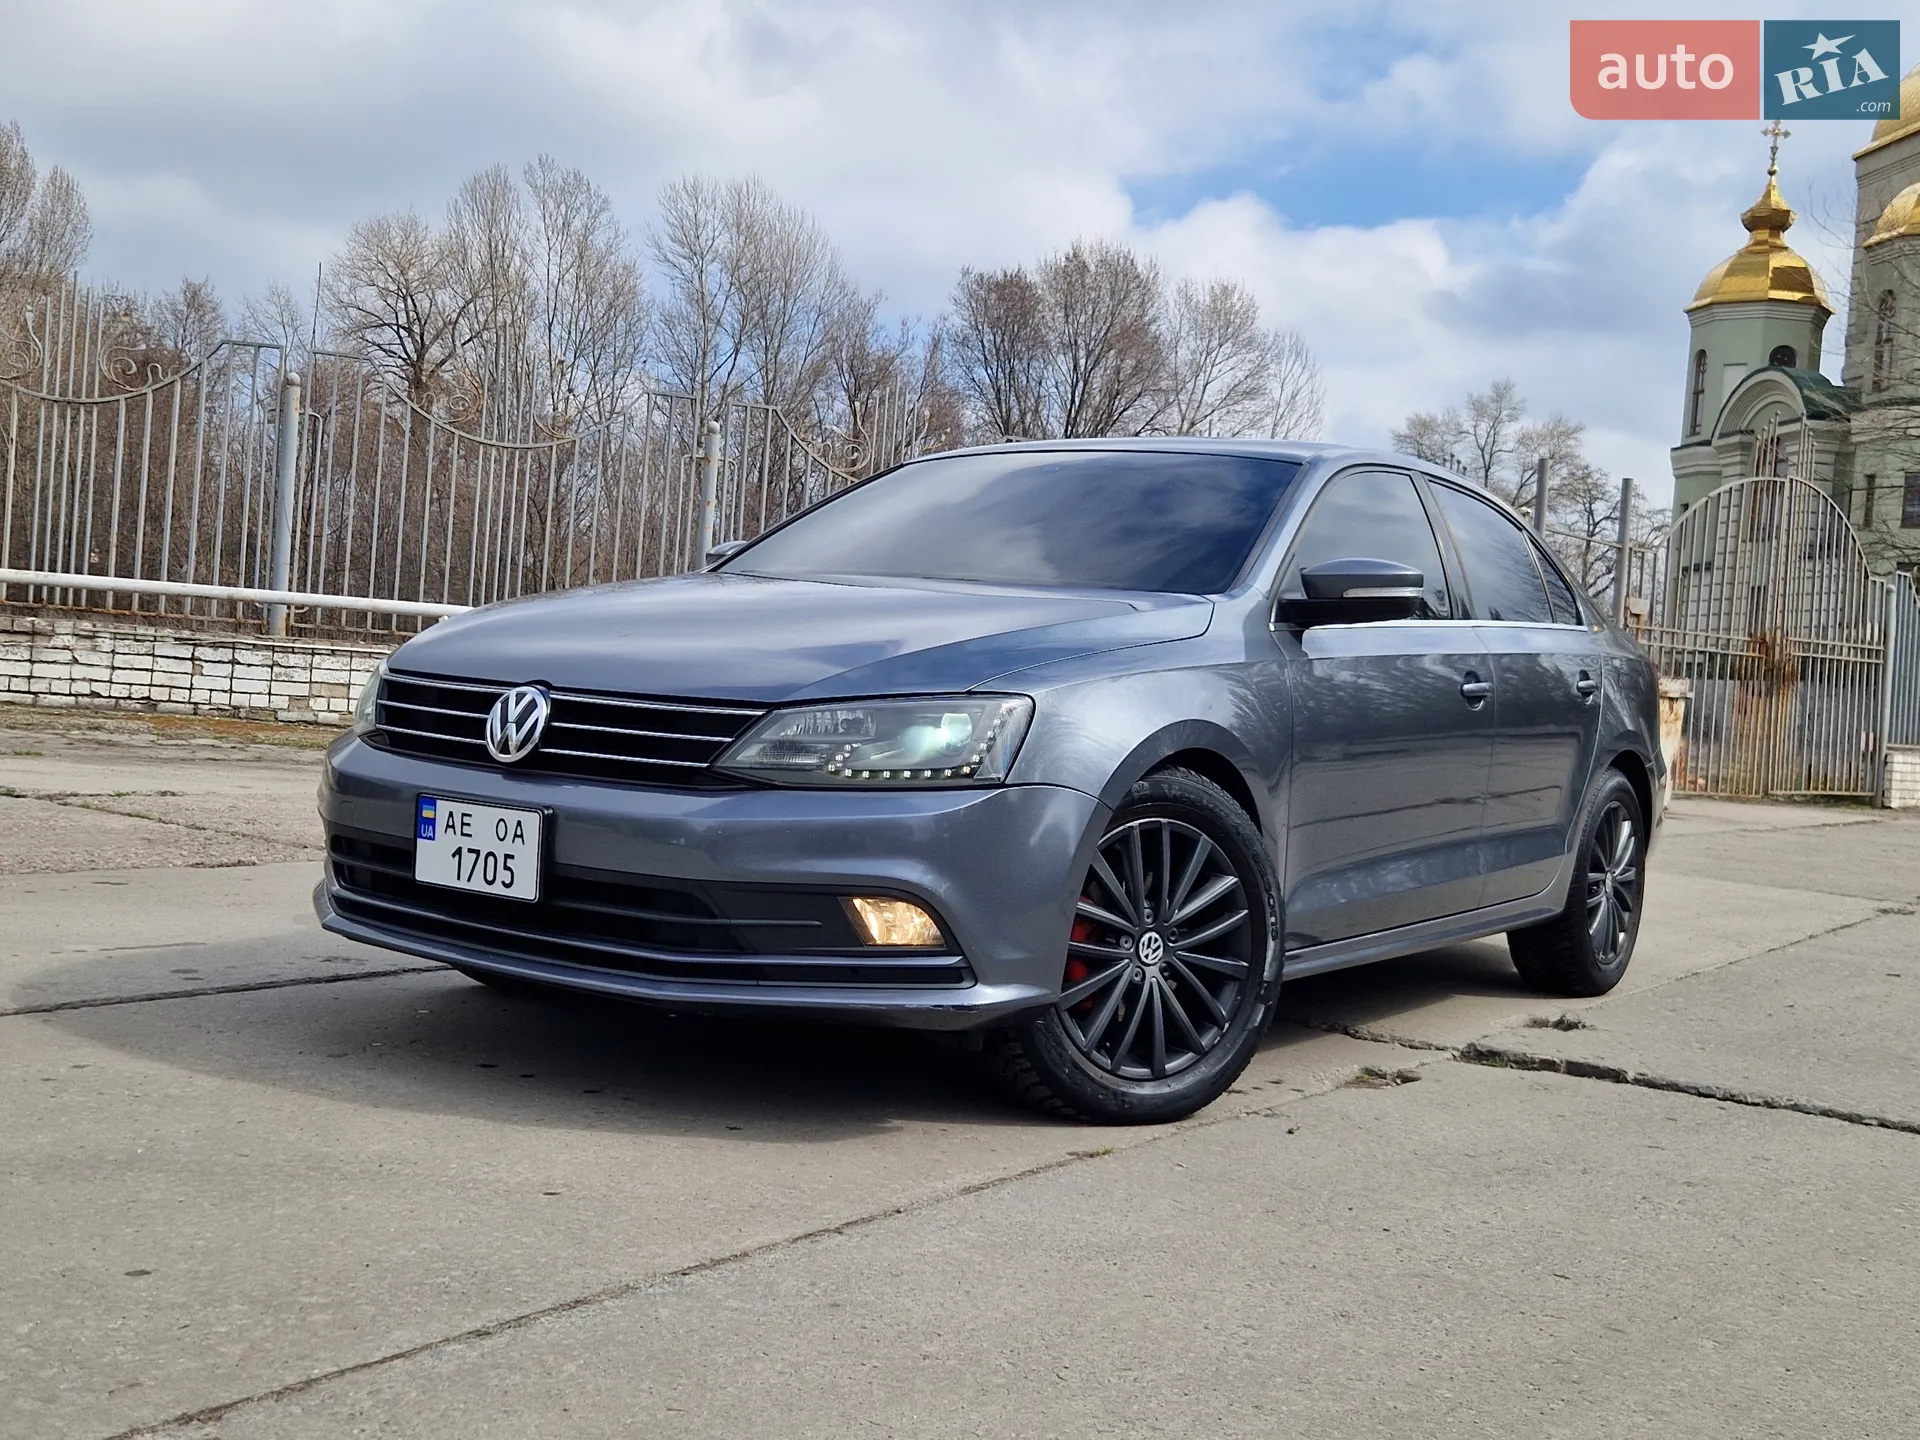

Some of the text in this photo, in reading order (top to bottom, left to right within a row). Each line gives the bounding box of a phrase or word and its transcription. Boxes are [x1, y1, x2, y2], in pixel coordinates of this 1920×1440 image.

[420, 824, 434, 840] UA
[444, 810, 526, 846] AE OA
[451, 846, 515, 889] 1705
